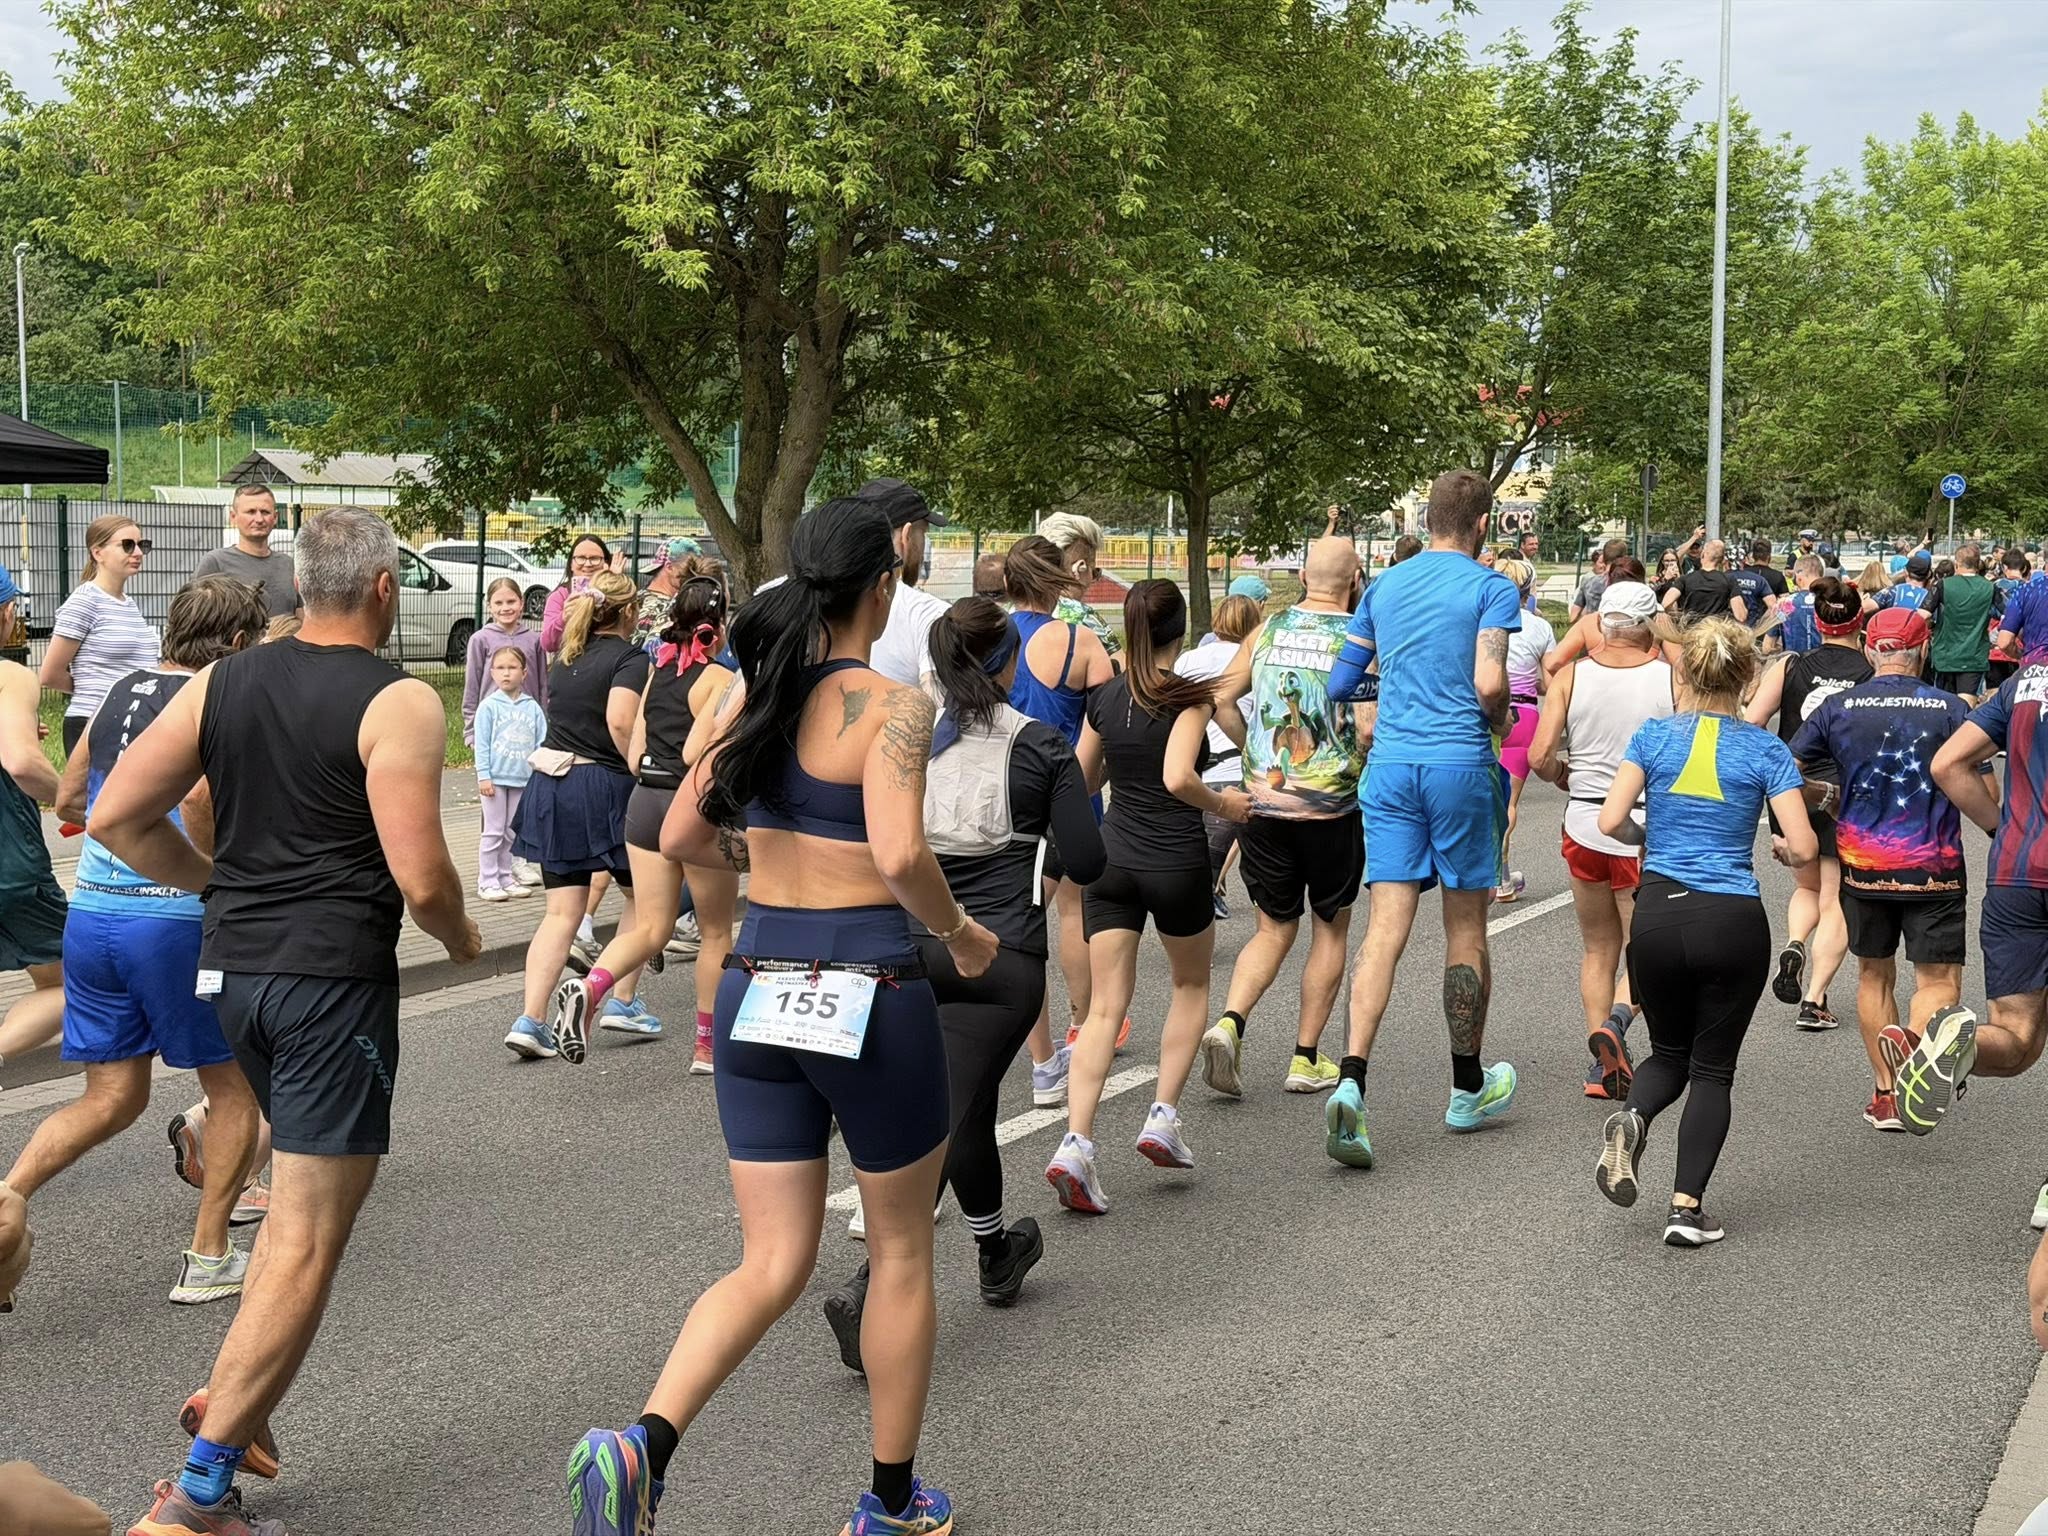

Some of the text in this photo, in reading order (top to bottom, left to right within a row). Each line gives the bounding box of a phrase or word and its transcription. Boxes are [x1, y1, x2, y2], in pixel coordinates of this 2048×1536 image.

[1272, 628, 1335, 653] FACET
[1264, 646, 1336, 673] ASIUNI
[1811, 676, 1856, 689] Policka
[1844, 697, 1948, 710] #NOCJESTNASZA
[757, 958, 809, 969] performance
[776, 991, 840, 1019] 155
[353, 1036, 392, 1095] DYNA
